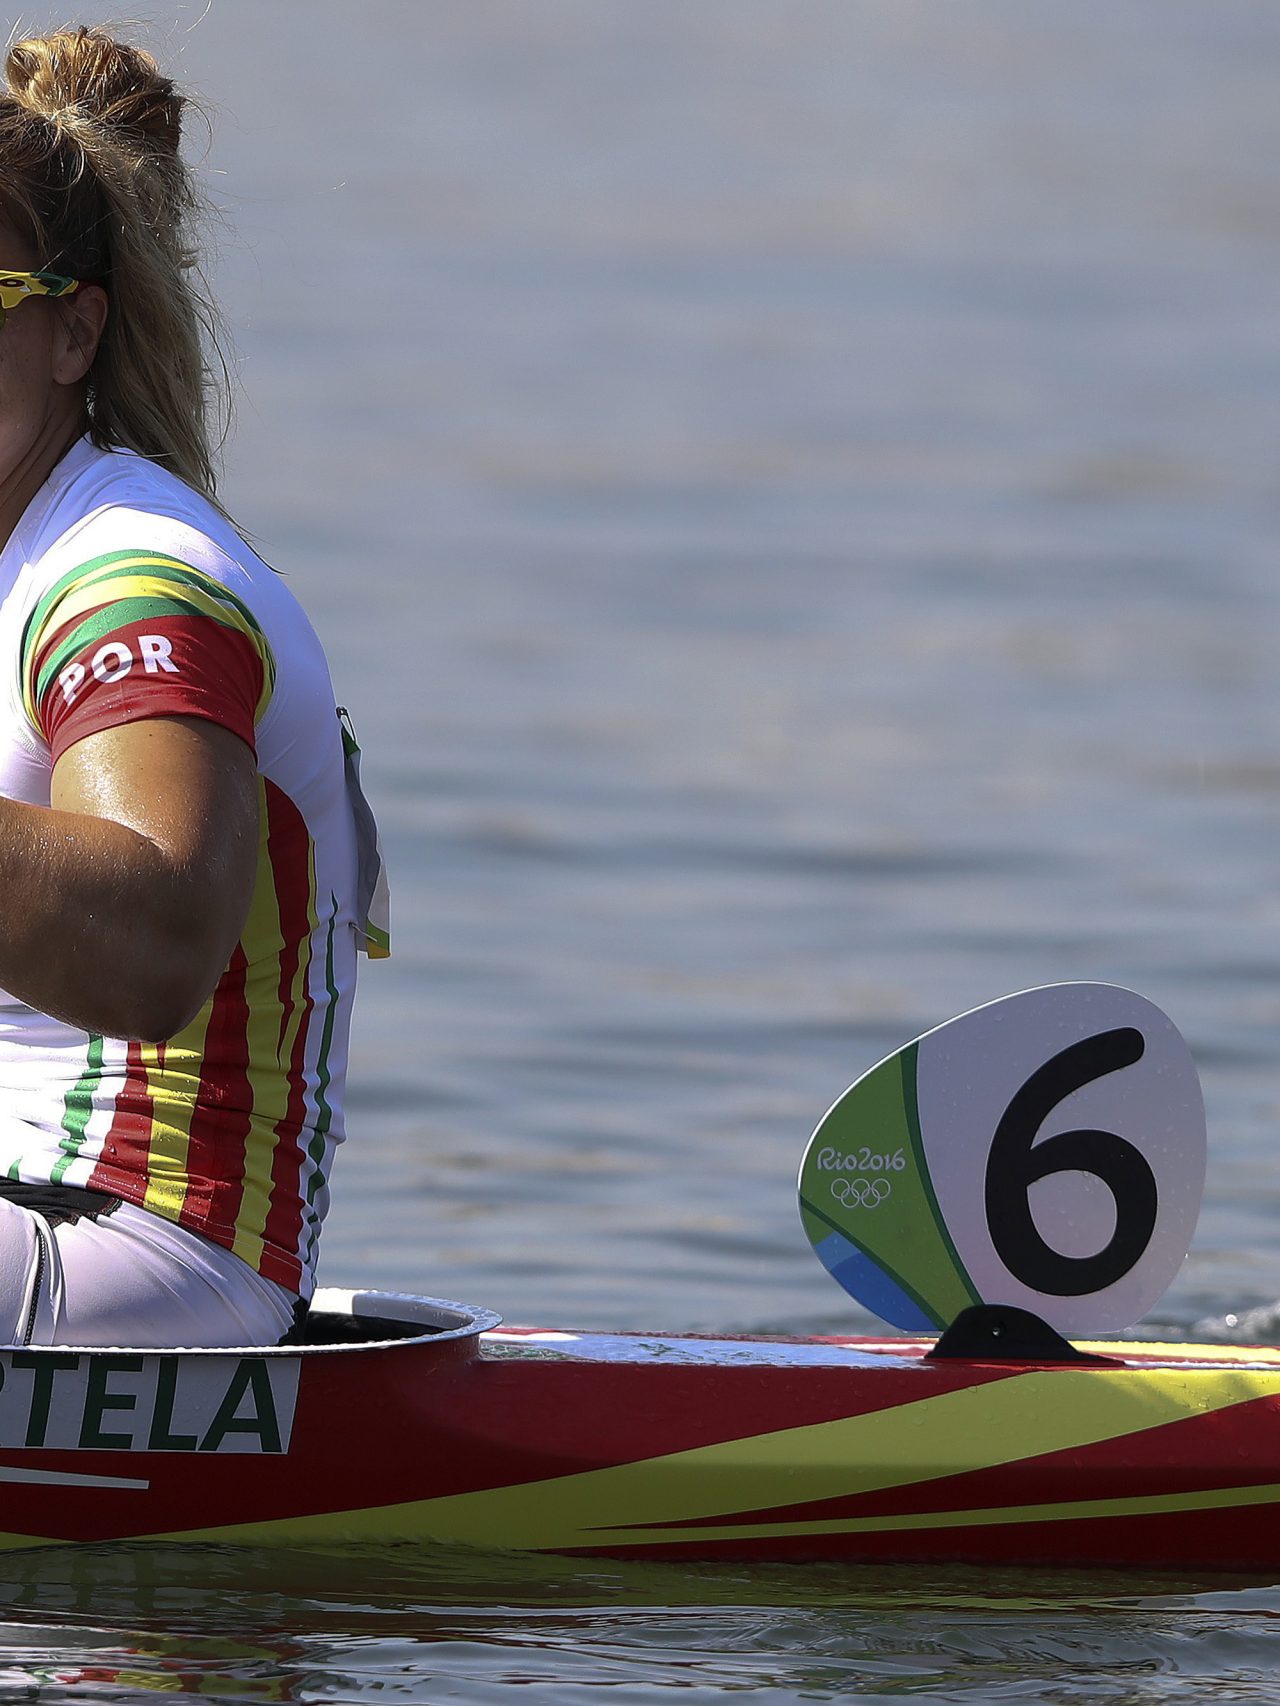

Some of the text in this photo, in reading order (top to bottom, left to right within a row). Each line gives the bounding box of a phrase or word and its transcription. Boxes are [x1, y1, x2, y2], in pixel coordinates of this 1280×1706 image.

[58, 635, 180, 706] POR
[817, 1147, 906, 1171] Rio2016
[985, 1027, 1158, 1297] 6
